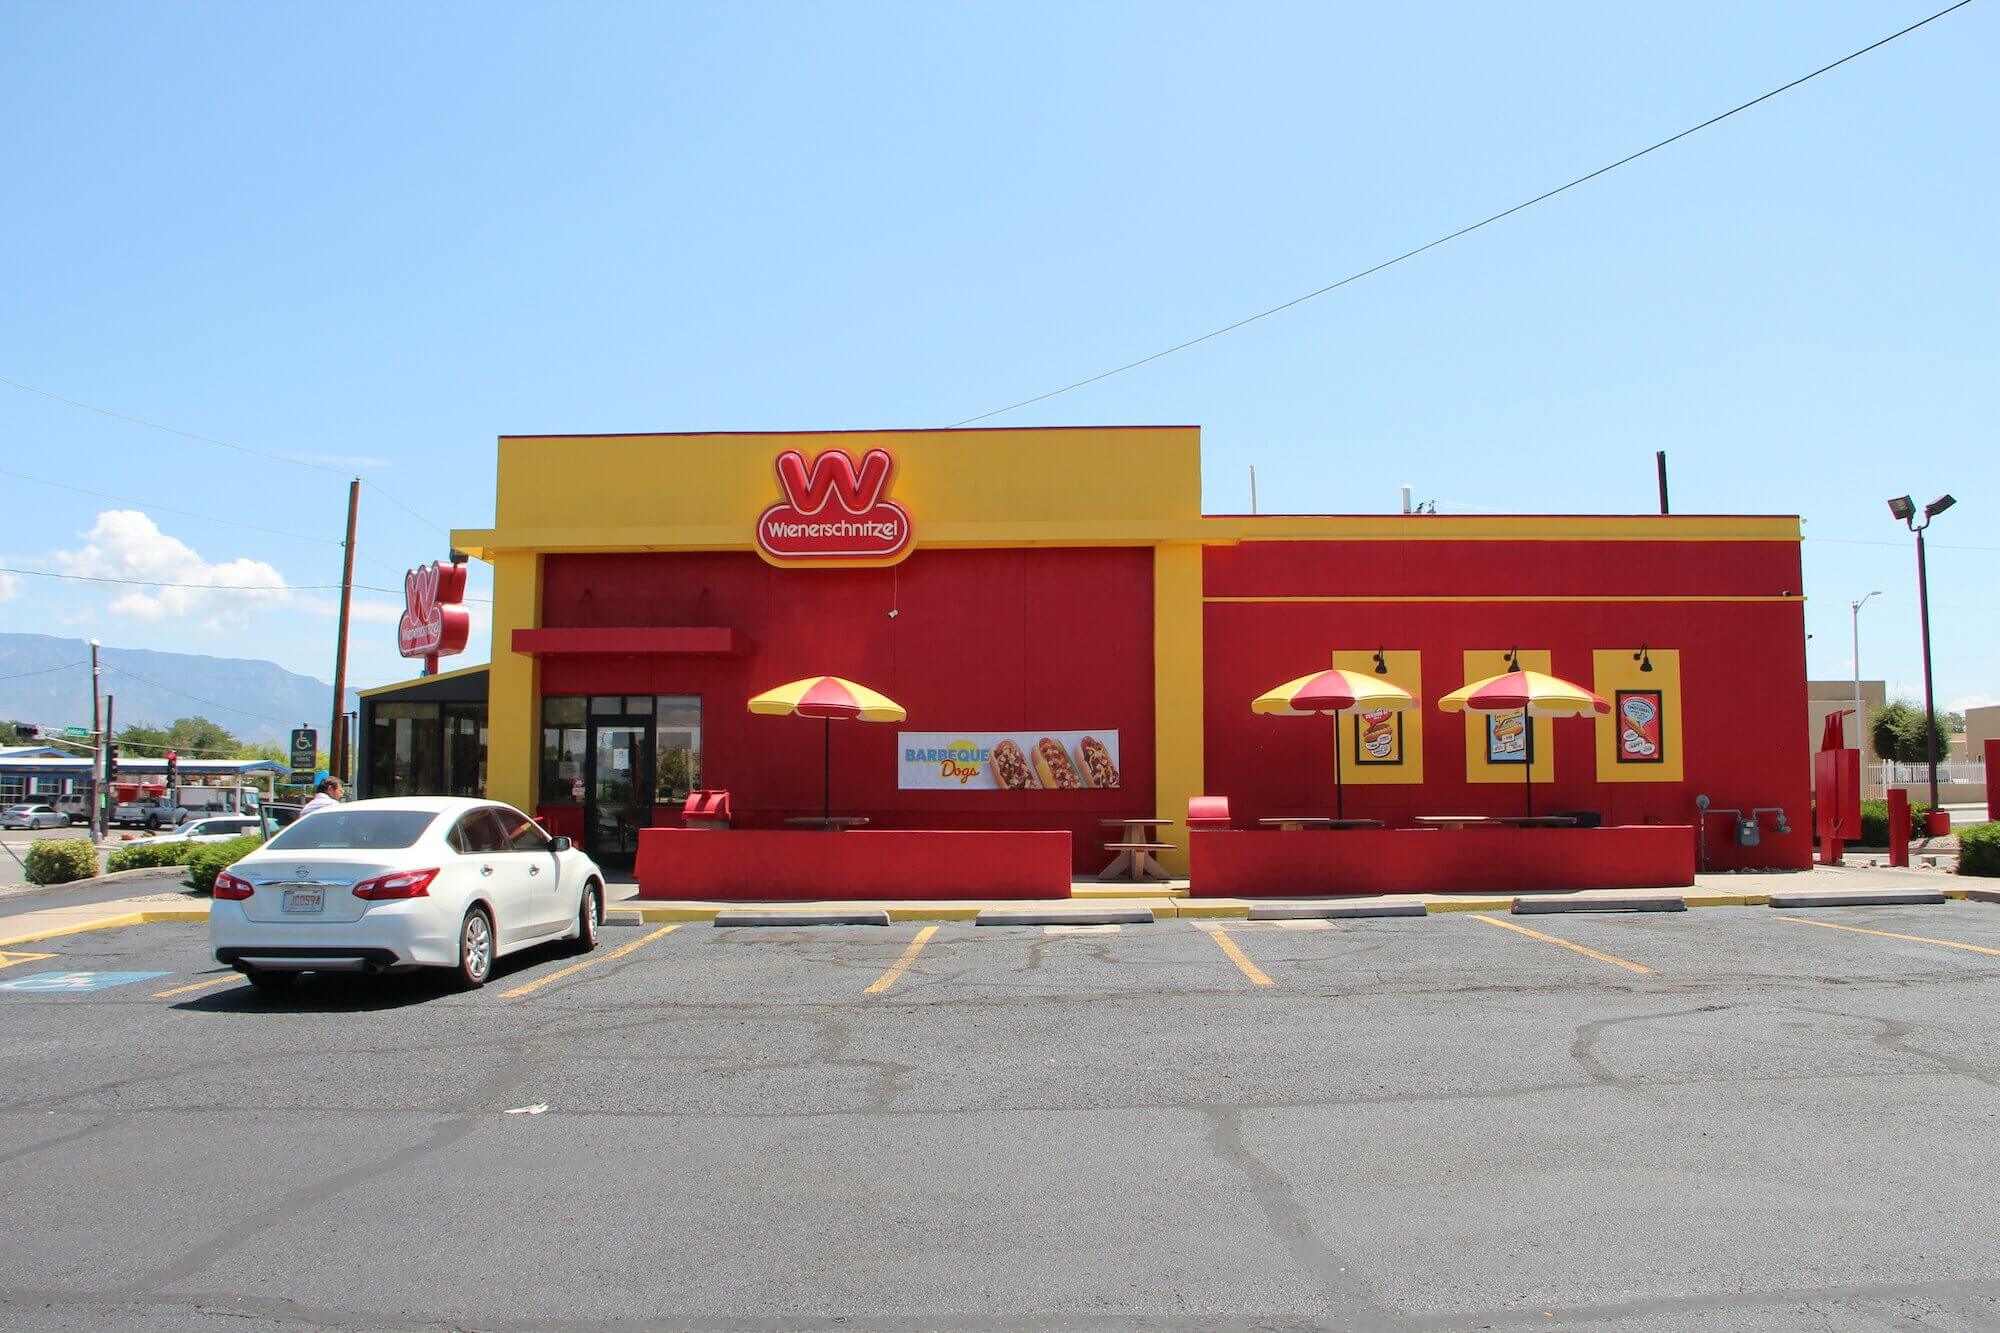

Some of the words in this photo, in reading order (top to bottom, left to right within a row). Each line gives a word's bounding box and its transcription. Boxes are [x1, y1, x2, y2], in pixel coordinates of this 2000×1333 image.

[767, 520, 898, 540] Wienerschnitzel
[905, 748, 990, 762] BARBEQUE
[941, 758, 981, 784] Dogs
